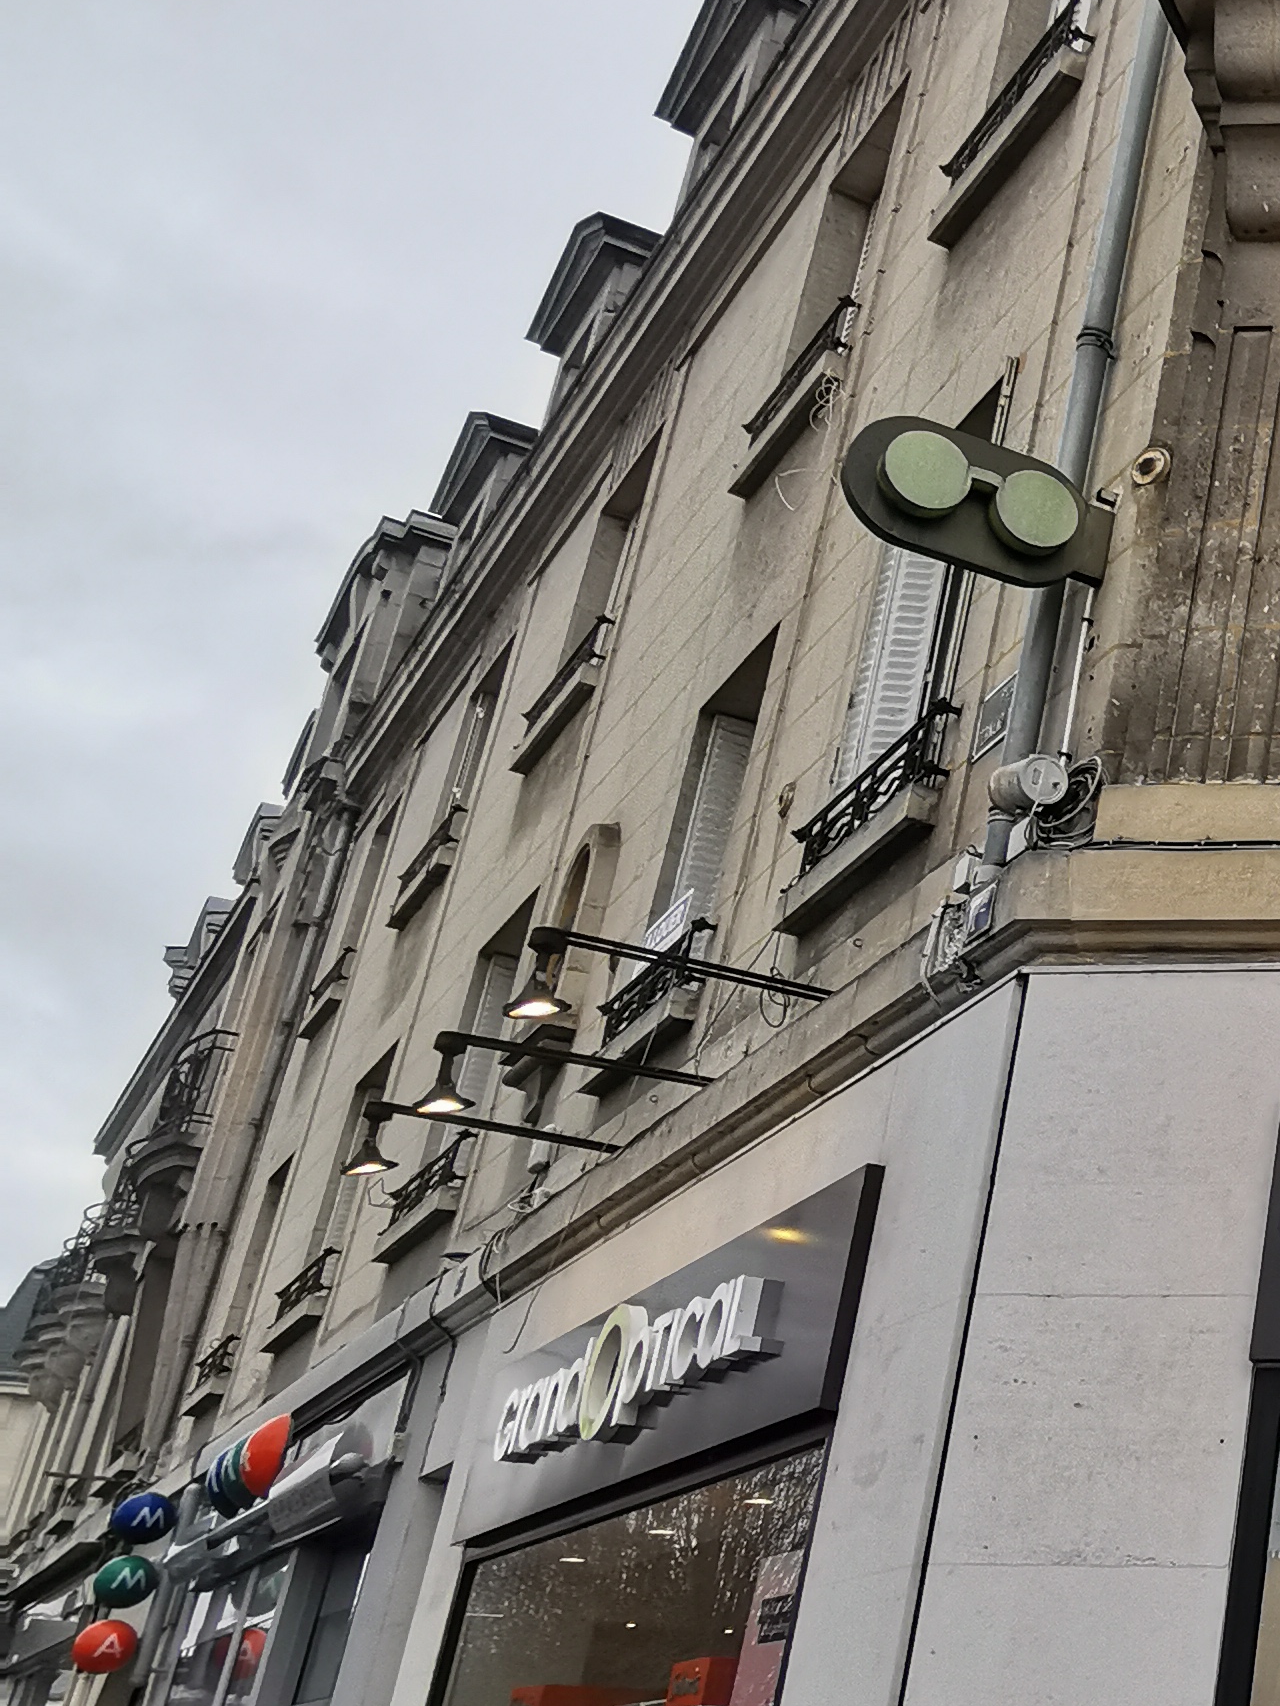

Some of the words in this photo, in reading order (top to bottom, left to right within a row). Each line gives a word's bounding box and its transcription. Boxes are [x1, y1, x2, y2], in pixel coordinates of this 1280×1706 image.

[130, 1506, 165, 1530] M
[110, 1566, 146, 1591] M
[92, 1632, 124, 1659] A
